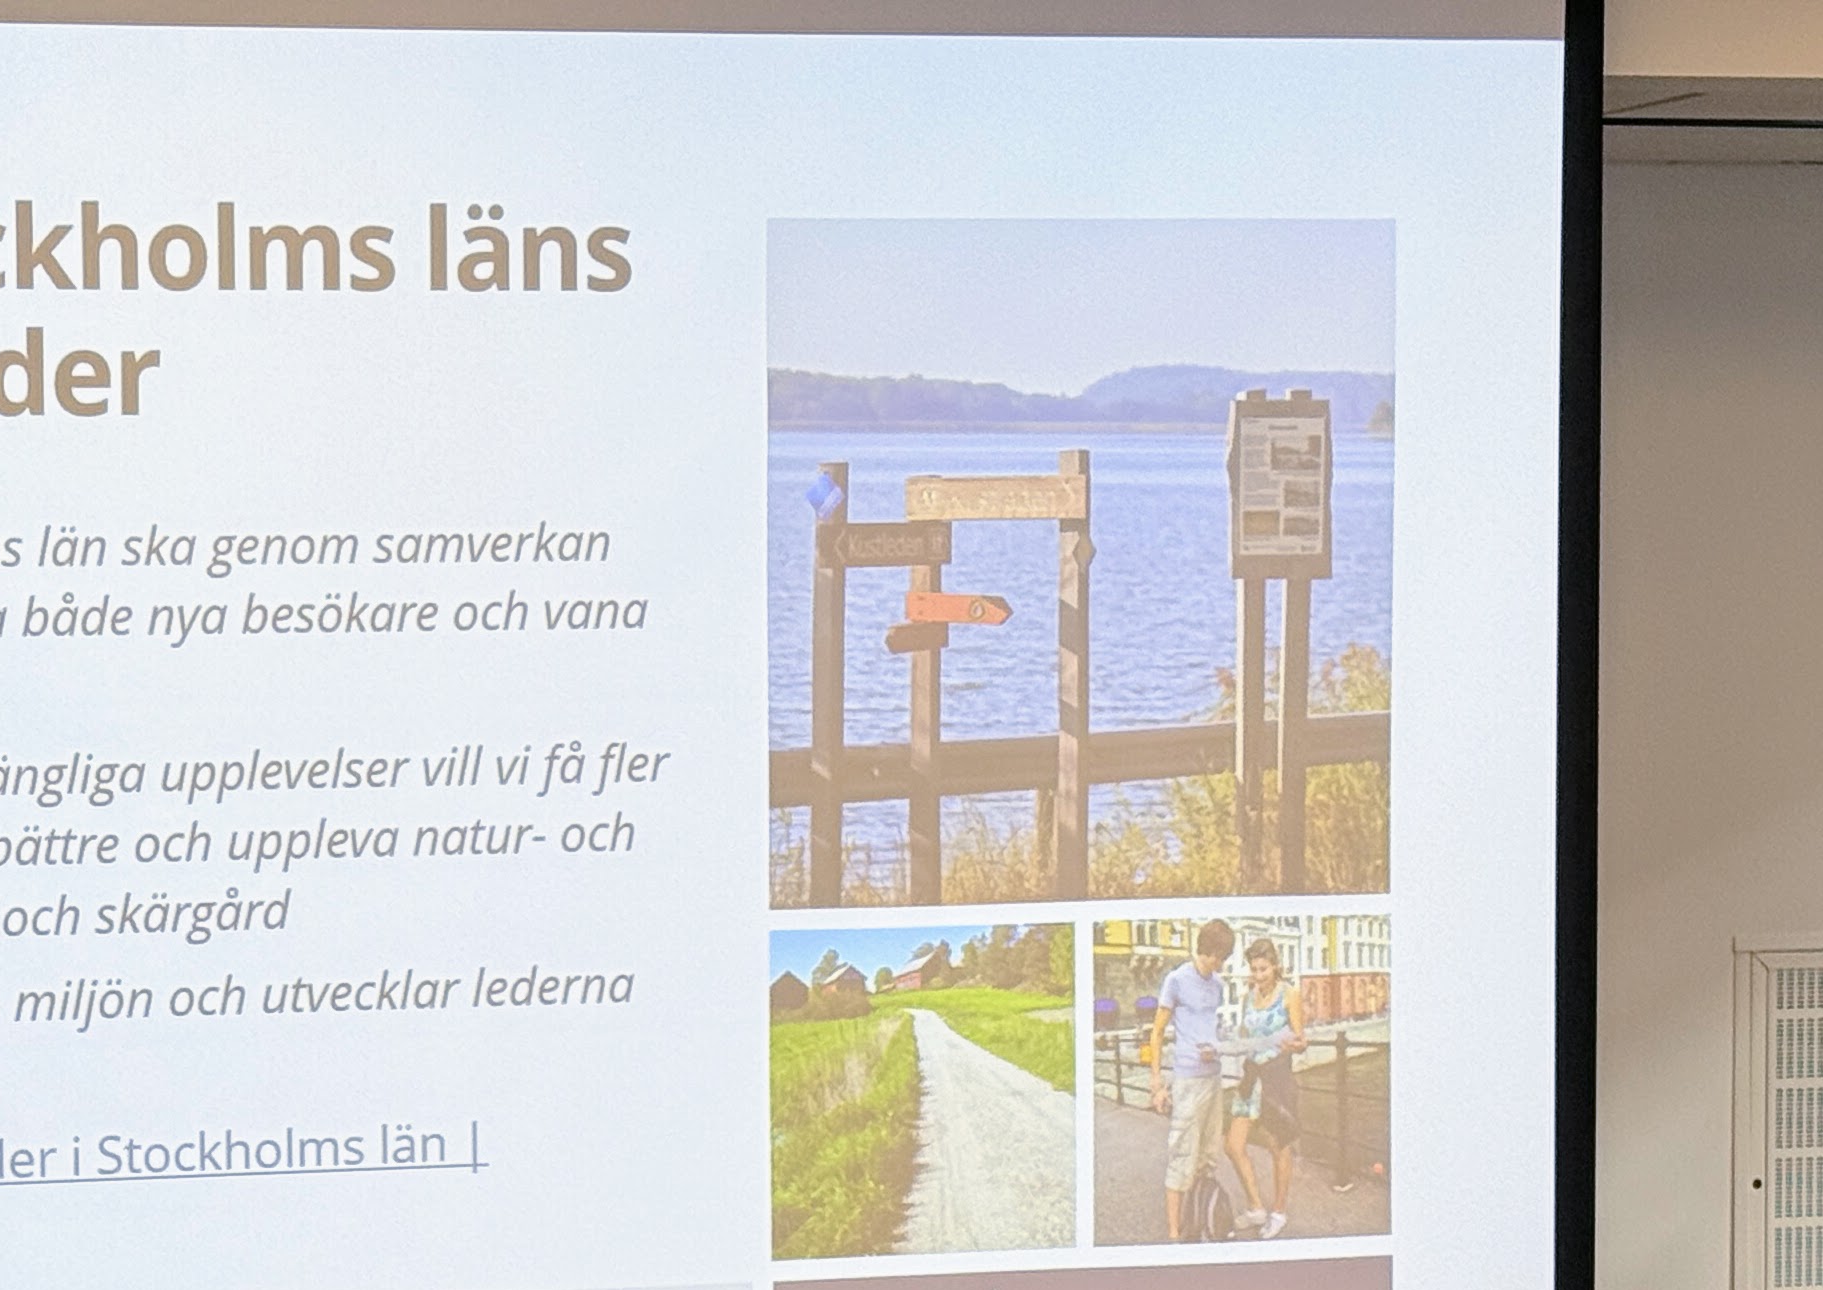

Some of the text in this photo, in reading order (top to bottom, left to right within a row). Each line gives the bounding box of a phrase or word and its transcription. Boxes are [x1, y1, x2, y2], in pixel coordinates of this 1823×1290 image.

[430, 203, 632, 292] läns
[38, 525, 106, 567] län
[121, 524, 196, 566] ska
[206, 534, 358, 579] genom
[372, 521, 610, 563] samverkan
[22, 592, 133, 637] både
[148, 605, 227, 648] nya
[242, 591, 438, 634] besökare
[454, 589, 528, 631] och
[544, 600, 648, 630] vana
[161, 747, 410, 805] upplevelser
[423, 745, 483, 787] vill
[496, 745, 531, 785] vi
[537, 740, 585, 797] få
[592, 742, 671, 796] fler
[135, 820, 211, 863] och
[228, 817, 399, 874] uppleva
[413, 819, 546, 856] natur-
[561, 811, 634, 852] och
[3, 894, 80, 936] och
[95, 887, 291, 945] skärgård
[14, 978, 153, 1033] miljön
[170, 974, 245, 1016] och
[263, 969, 461, 1014] utvecklar
[472, 965, 634, 1007] lederna
[71, 1135, 85, 1182] i
[97, 1128, 366, 1180] Stockholms
[378, 1125, 448, 1172] län
